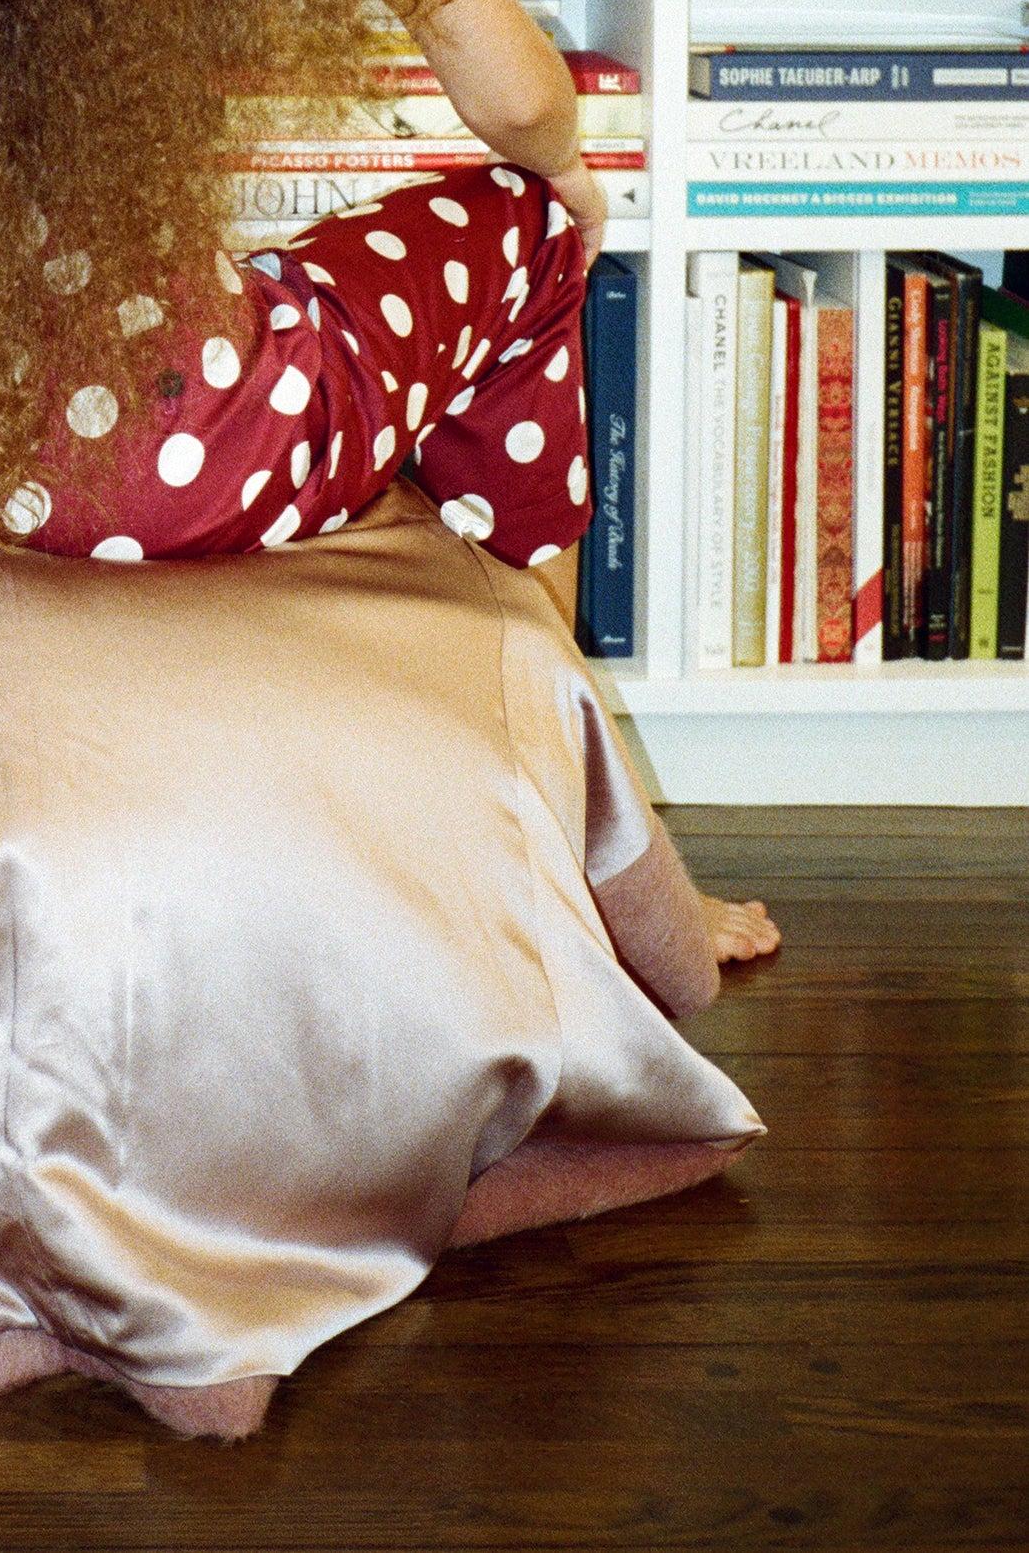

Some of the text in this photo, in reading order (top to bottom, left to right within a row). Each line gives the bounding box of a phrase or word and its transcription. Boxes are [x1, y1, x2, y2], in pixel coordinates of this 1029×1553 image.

[719, 67, 881, 87] SOPHIE TAEUBER-ARP
[718, 107, 841, 136] Chanel
[333, 153, 414, 169] POSTERS
[709, 150, 1021, 171] VREELAND MEMOS
[235, 179, 356, 215] JOHN
[696, 193, 739, 205] DAVID
[742, 193, 808, 205] HOCKNEY
[821, 193, 874, 205] BIGGER
[876, 193, 957, 205] EXHIBITION
[887, 296, 902, 467] GIANNI VERSACE
[609, 414, 625, 444] The
[980, 342, 1001, 518] AGAINST FASHION
[710, 294, 727, 609] CHANEL THE VOCABULARY OF STYLE
[603, 448, 626, 501] History
[602, 505, 624, 523] of
